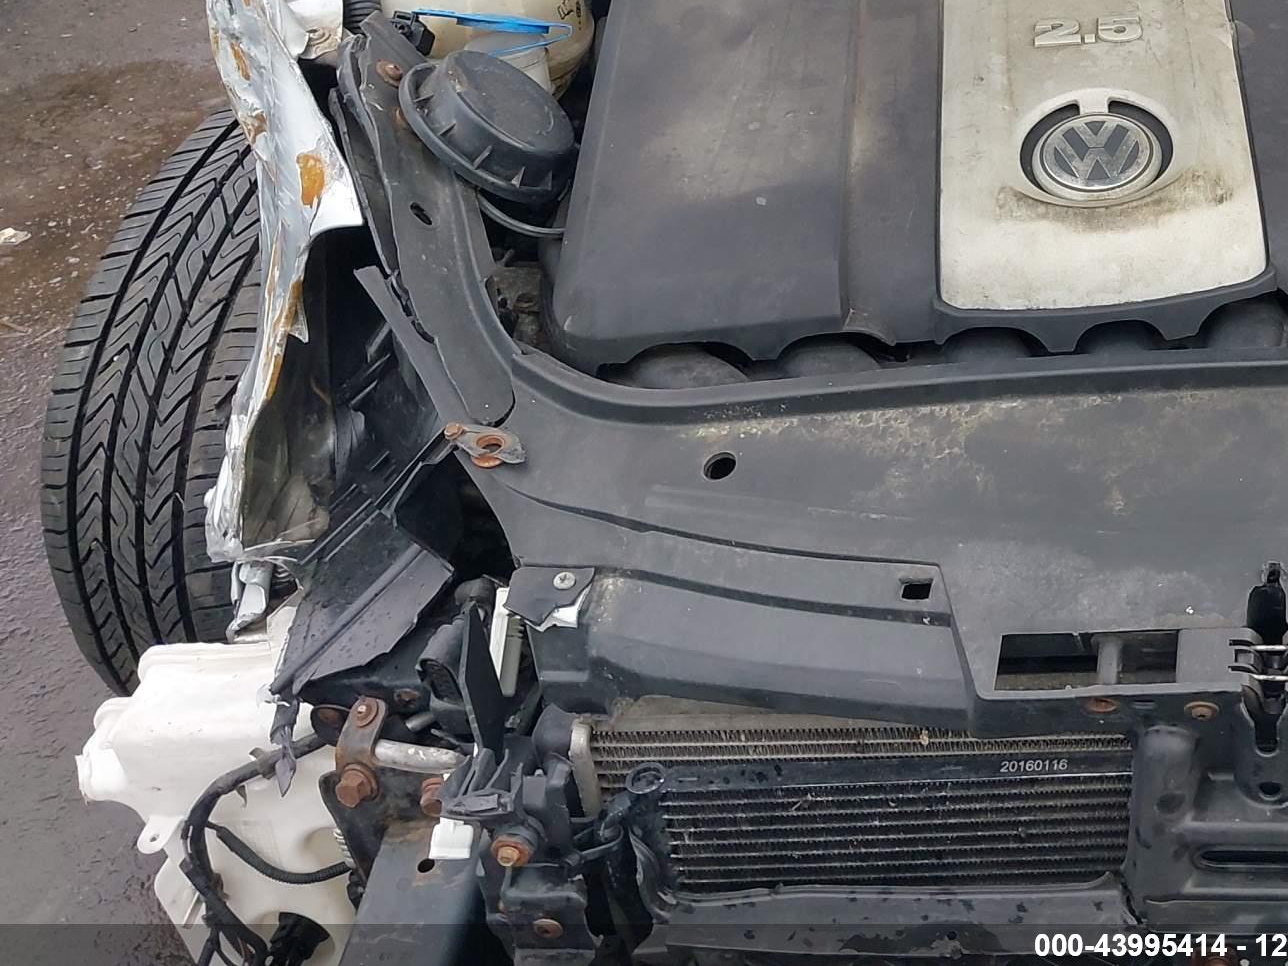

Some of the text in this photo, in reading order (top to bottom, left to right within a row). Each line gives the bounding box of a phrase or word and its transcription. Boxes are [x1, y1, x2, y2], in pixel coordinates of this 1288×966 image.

[1034, 16, 1143, 47] 2.5
[1043, 115, 1151, 189] VW
[1000, 758, 1068, 773] 20160116
